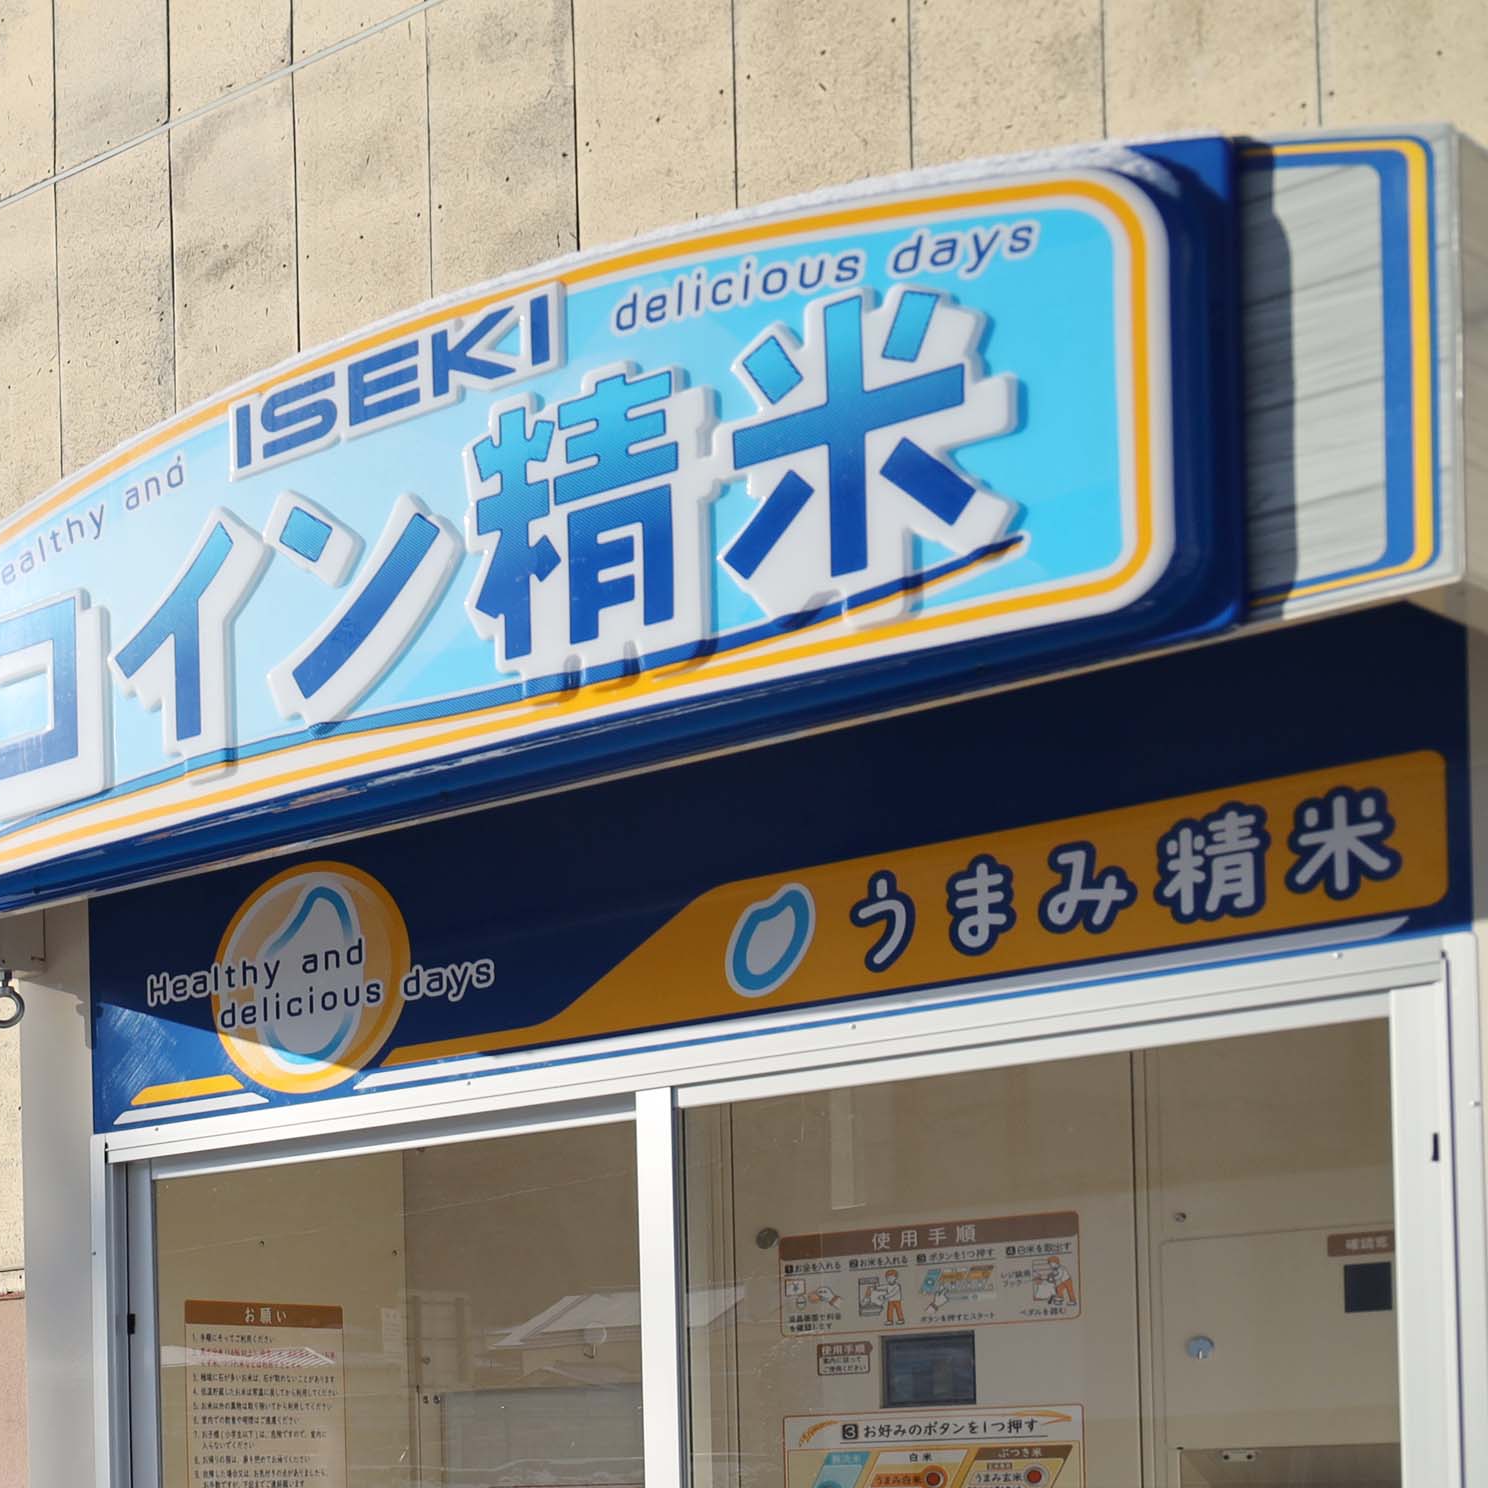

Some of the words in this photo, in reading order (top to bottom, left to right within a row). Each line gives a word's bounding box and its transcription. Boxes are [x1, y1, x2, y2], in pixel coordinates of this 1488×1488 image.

[615, 254, 861, 332] delicious
[892, 223, 1034, 273] days
[236, 294, 548, 469] ISEKI
[124, 455, 185, 511] and
[858, 794, 1392, 966] うまみ精米
[149, 958, 281, 1004] Healthy
[302, 937, 365, 974] and
[220, 980, 382, 1029] delicious
[403, 959, 494, 1000] days
[872, 1225, 977, 1249] 使用手順
[244, 1307, 287, 1324] お願い
[864, 1419, 1038, 1439] お好みのボタンを1つ押す
[910, 1453, 933, 1462] 白米
